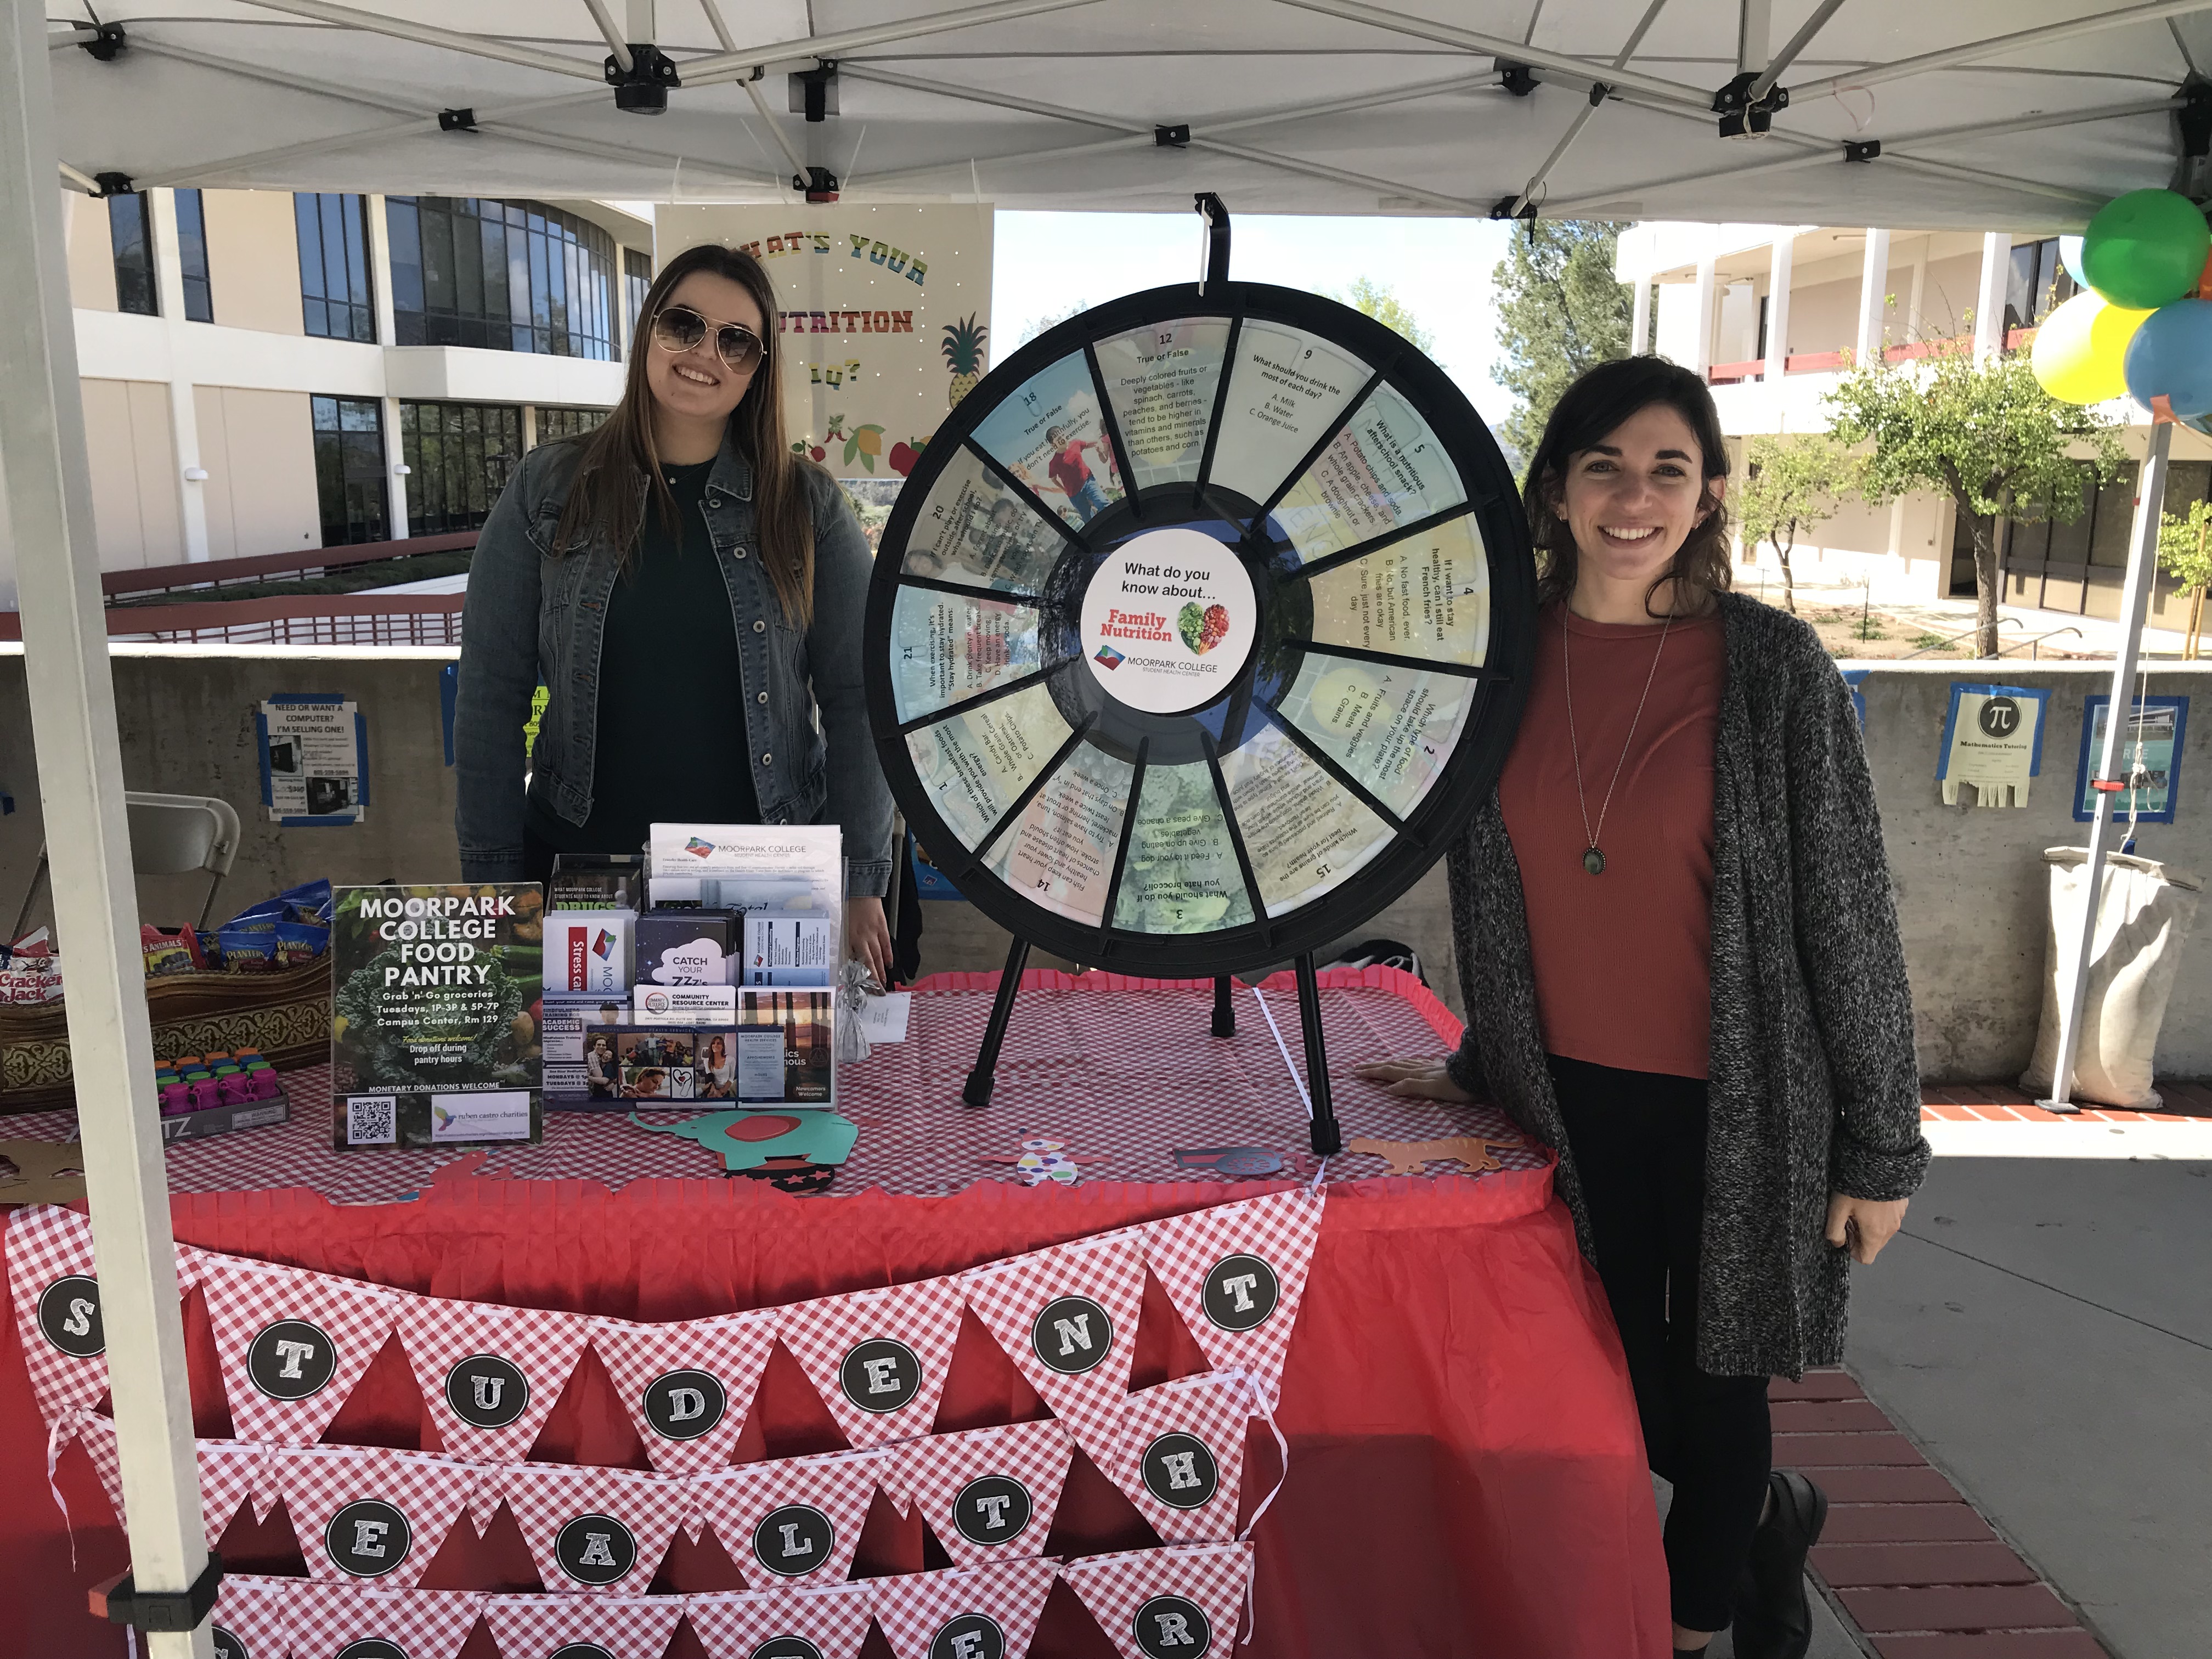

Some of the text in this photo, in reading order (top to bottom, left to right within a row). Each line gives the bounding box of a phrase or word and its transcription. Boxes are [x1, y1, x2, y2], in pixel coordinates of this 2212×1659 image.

[739, 232, 928, 286] HAT'S YOUR
[780, 311, 913, 332] TRITION
[1159, 333, 1172, 344] 12
[1137, 354, 1154, 363] True
[1166, 348, 1189, 358] False
[1304, 348, 1313, 360] 9
[808, 359, 860, 391] IQ?
[1252, 354, 1341, 395] What should you drink the
[1261, 370, 1322, 400] most of each day?
[1022, 391, 1038, 406] 18
[1271, 393, 1296, 408] A. Milk
[1264, 402, 1294, 419] B. Water
[1024, 403, 1063, 436] True or False
[1249, 407, 1299, 432] C. Orange Juice
[1374, 419, 1393, 441] What
[1389, 439, 1398, 449] is
[1397, 454, 1427, 490] nutritious
[1414, 444, 1425, 454] 5
[1365, 427, 1417, 496] afterschool snack?
[933, 505, 944, 520] 20
[1125, 562, 1210, 582] What do you
[1122, 581, 1216, 600] know about...
[1108, 610, 1166, 630] Family
[1101, 624, 1172, 642] Nutrition
[904, 646, 913, 659] 21
[1128, 657, 1217, 673] MOORPARK COLLEGE
[1423, 745, 1435, 755] 2
[940, 782, 947, 792] 1
[1317, 864, 1331, 878] 15
[1037, 878, 1052, 891] 14
[1143, 882, 1181, 890] broccoli?
[1204, 878, 1220, 886] you
[1158, 891, 1172, 900] you
[1176, 891, 1203, 900] should
[360, 896, 516, 918] MOORPARK
[1176, 909, 1183, 919] 3
[380, 919, 495, 940] COLLEGE
[150, 939, 181, 951] ANIMALS
[276, 941, 313, 951] PLANTERS
[227, 950, 264, 960] PLANTERS
[401, 943, 475, 963] FOOD
[573, 941, 584, 974] Stress
[0, 974, 63, 988] Cracker
[385, 965, 492, 986] PANTRY
[4, 988, 47, 1002] Jack
[382, 991, 409, 1000] Grab
[444, 990, 493, 1000] groceries
[376, 1005, 428, 1014] Tuesdays,
[432, 1003, 458, 1012] 1P-3P
[471, 1002, 499, 1011] 5P-7P
[377, 1018, 420, 1028] Campus
[465, 1015, 479, 1024] Rm
[483, 1015, 498, 1023] 129
[448, 1034, 478, 1042] welcome!
[410, 1043, 466, 1054] Drop off during
[414, 1055, 462, 1065] pantry hours
